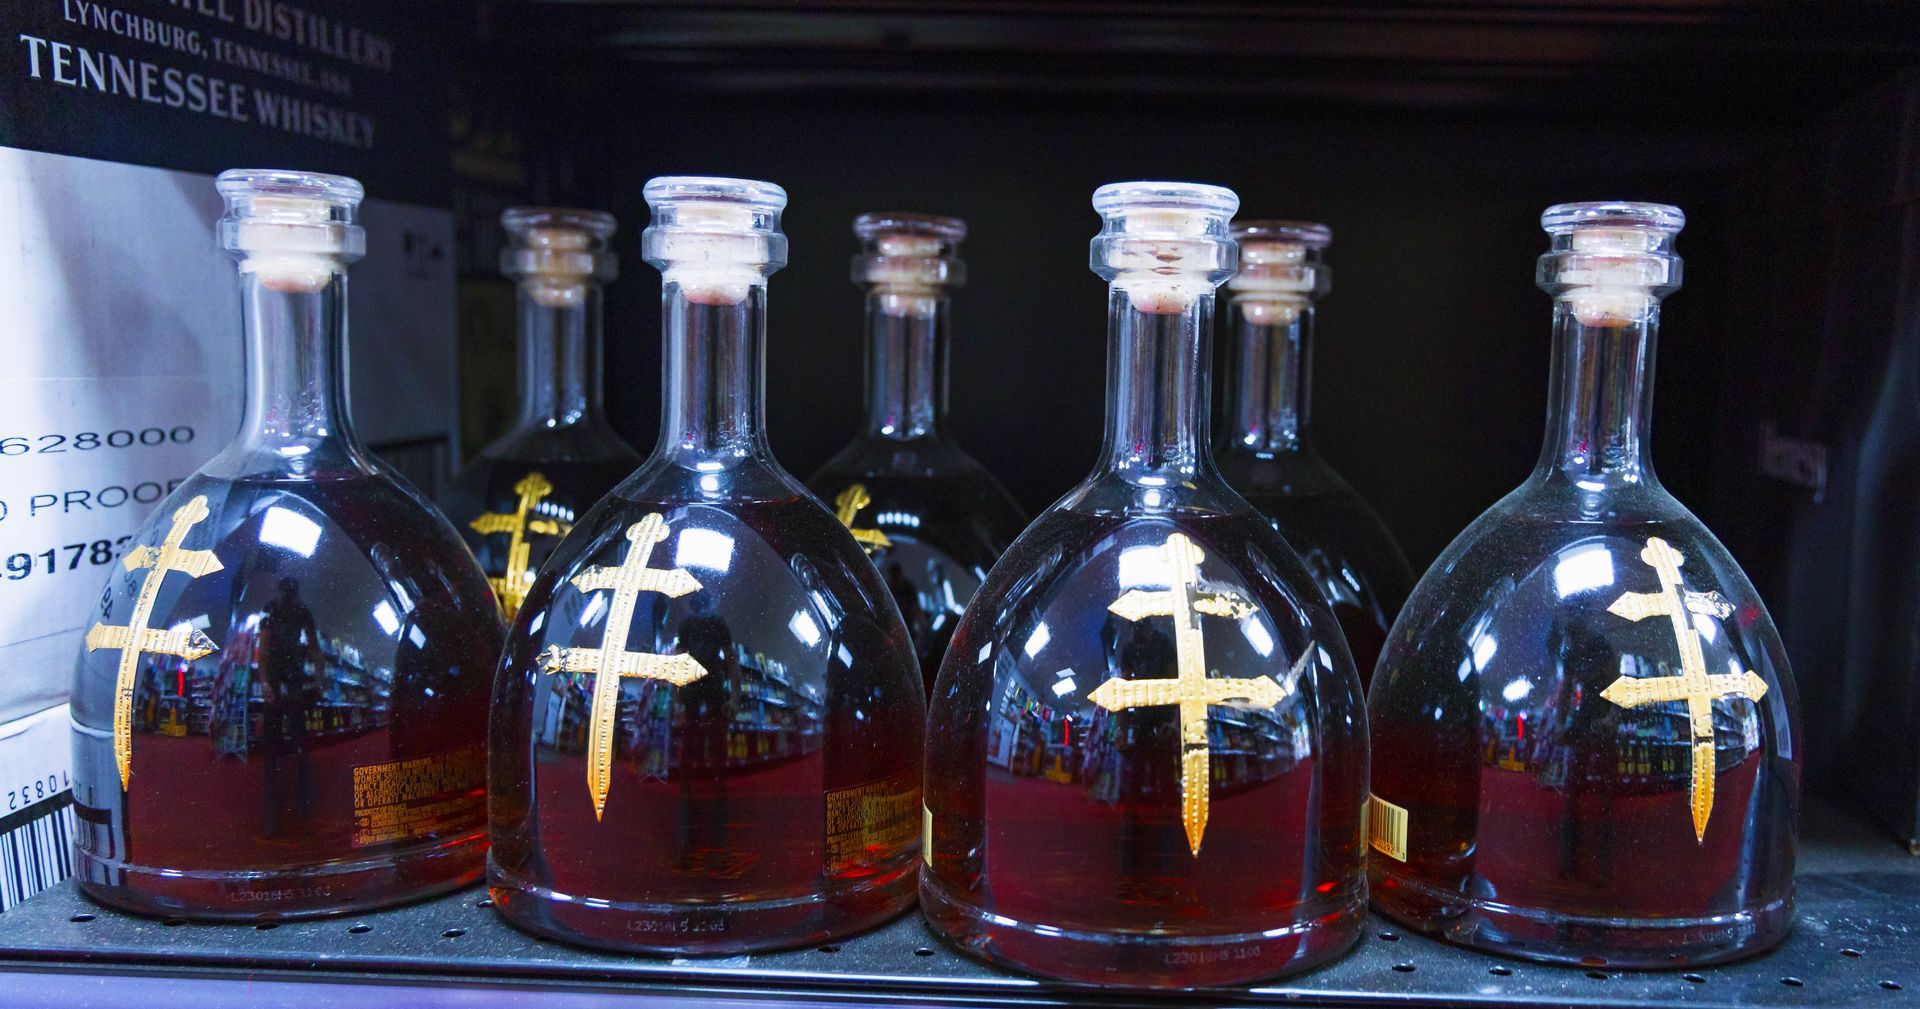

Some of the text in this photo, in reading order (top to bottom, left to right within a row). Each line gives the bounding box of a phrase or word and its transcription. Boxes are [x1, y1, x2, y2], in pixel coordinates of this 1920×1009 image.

[63, 0, 208, 60] LYNCHBURG,
[20, 34, 375, 149] TENNESSEE WHISKEY
[0, 426, 195, 456] 628000
[8, 770, 70, 810] 10832
